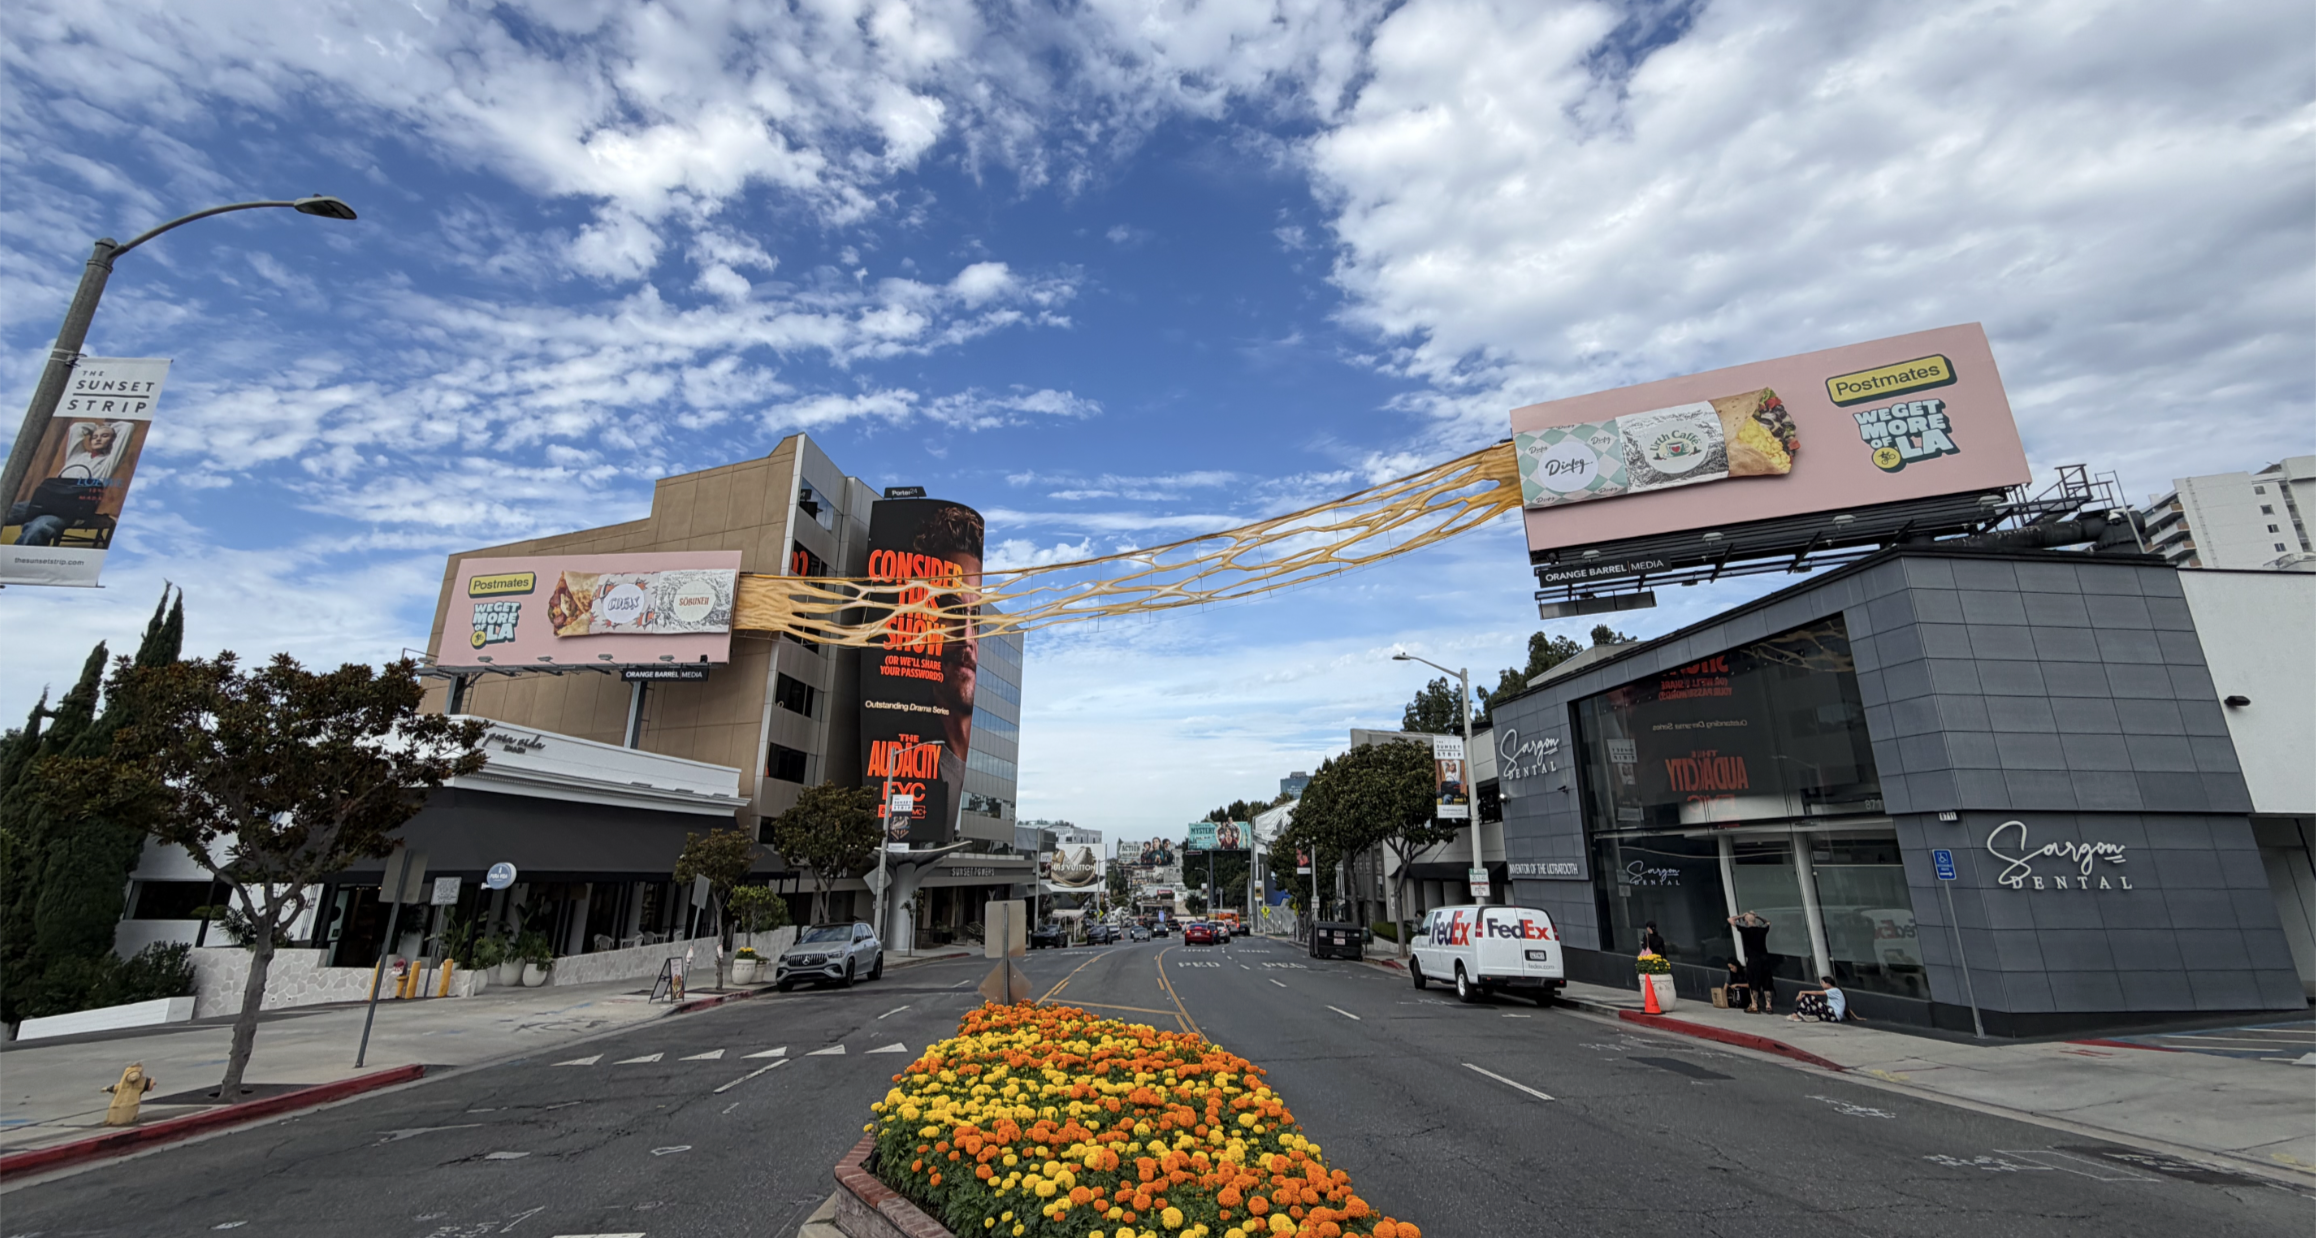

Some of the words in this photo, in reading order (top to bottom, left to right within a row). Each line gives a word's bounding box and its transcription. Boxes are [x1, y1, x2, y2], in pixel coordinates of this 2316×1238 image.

[76, 380, 155, 392] SUNSET
[1835, 365, 1941, 396] Postmates
[67, 399, 147, 413] STRIP
[1854, 408, 1892, 424] WE
[1891, 399, 1940, 418] GET
[1860, 413, 1946, 440] MORE
[1650, 433, 1670, 451] Urth
[1871, 437, 1892, 449] OF
[1895, 428, 1954, 459] LA
[14, 557, 84, 567] thesunsetstrip.com
[1545, 569, 1587, 582] ORANGE
[1589, 564, 1627, 576] BARREL
[1631, 559, 1665, 571] MEDIA
[868, 549, 963, 597] CONSIDER
[473, 579, 529, 591] Postmates
[474, 603, 493, 613] WE
[493, 601, 520, 613] GET
[472, 612, 518, 624] MORE
[474, 623, 486, 632] OF
[486, 623, 514, 641] LA
[883, 616, 946, 656] SHOW
[885, 655, 899, 665] (OR
[900, 656, 920, 668] WE'LL
[921, 659, 942, 671] SHARE
[880, 665, 900, 676] YOUR
[901, 667, 944, 683] PASSWORDS)
[865, 700, 909, 712] Outstanding
[909, 703, 932, 713] Drama
[932, 706, 950, 716] Series
[898, 733, 919, 743] THE
[867, 740, 942, 779] AUDACITY
[1500, 728, 1559, 777] Sargon
[1508, 761, 1557, 780] DENTAL
[882, 781, 926, 802] FYC
[1987, 820, 2127, 885] Sargon
[1066, 864, 1096, 872] VUITTON
[1509, 863, 1530, 875] INVENTOR
[1530, 863, 1536, 875] OF
[1537, 863, 1547, 875] THE
[2011, 876, 2133, 890] DENTAL
[1432, 911, 1471, 946] FedEx
[1487, 918, 1552, 940] FedEx
